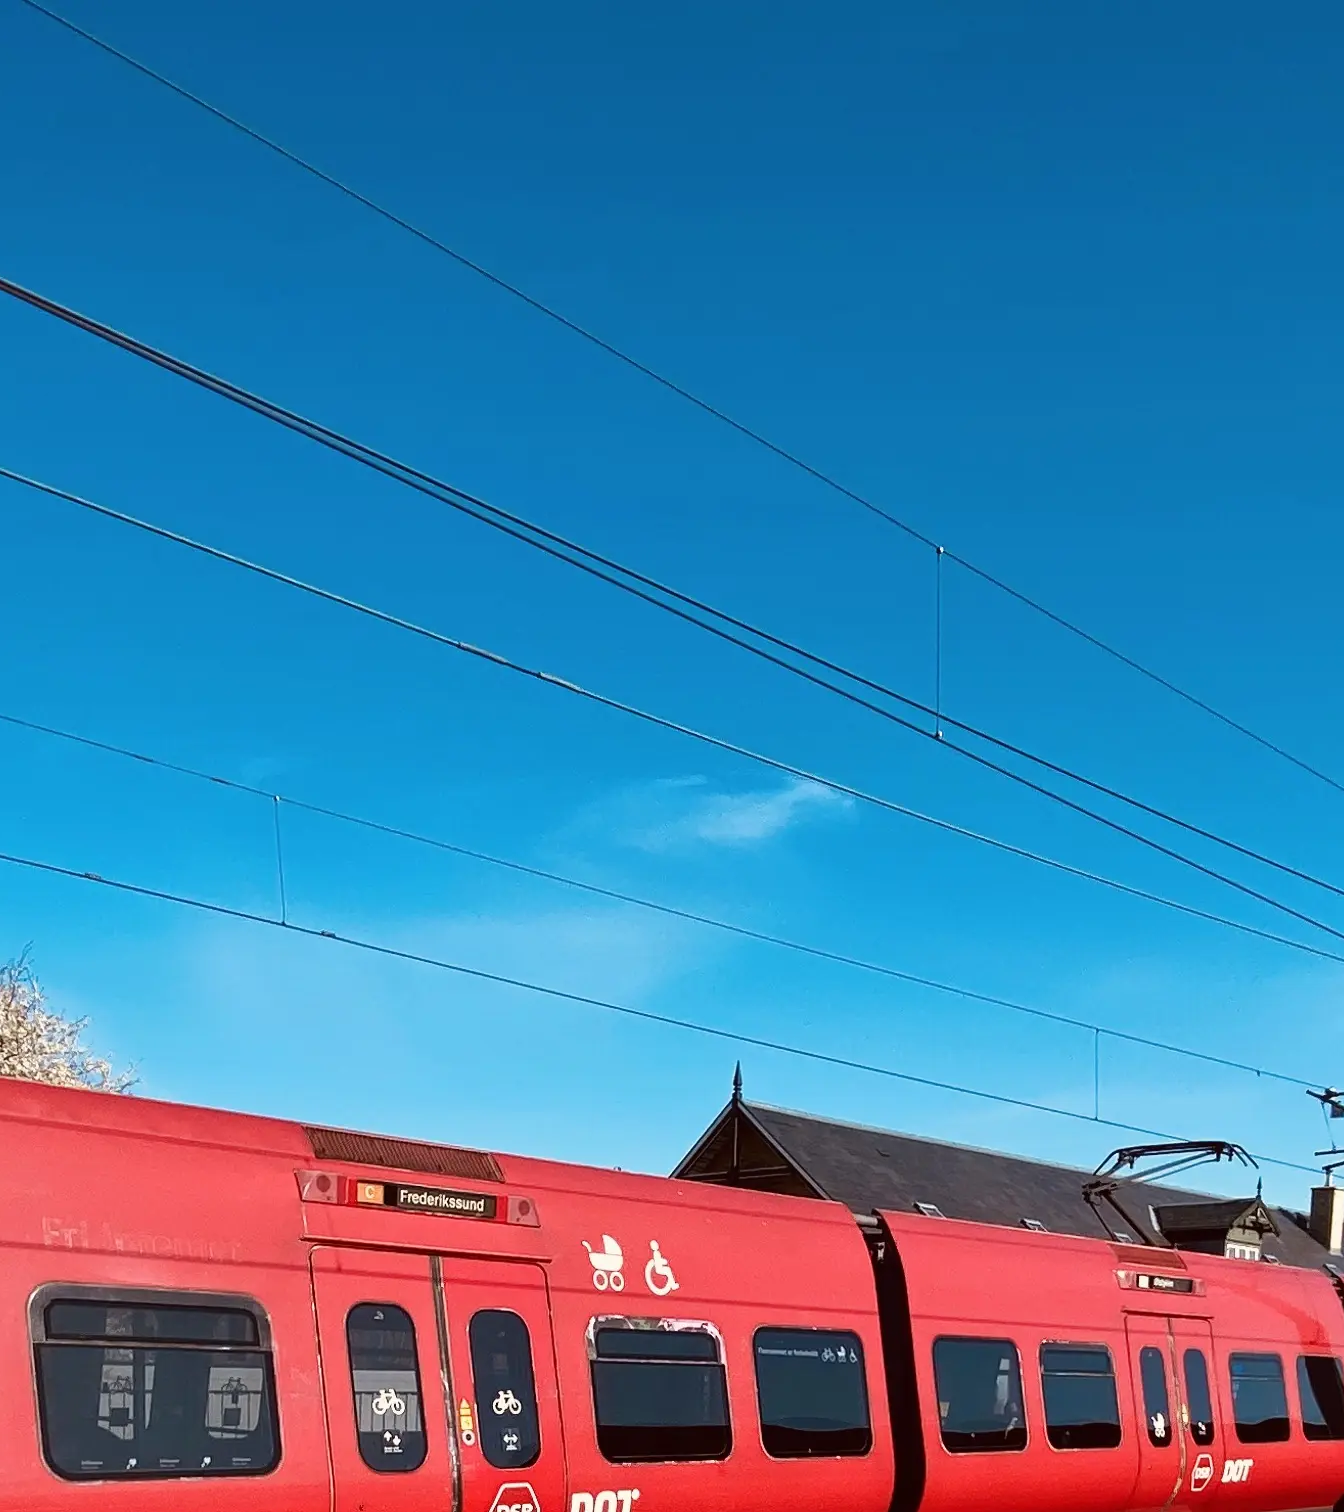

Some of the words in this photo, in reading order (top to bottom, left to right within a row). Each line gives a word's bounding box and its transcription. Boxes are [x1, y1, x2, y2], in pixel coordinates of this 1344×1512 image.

[364, 1185, 375, 1199] C
[400, 1189, 485, 1212] Frederikssund
[1221, 1458, 1254, 1483] DOT
